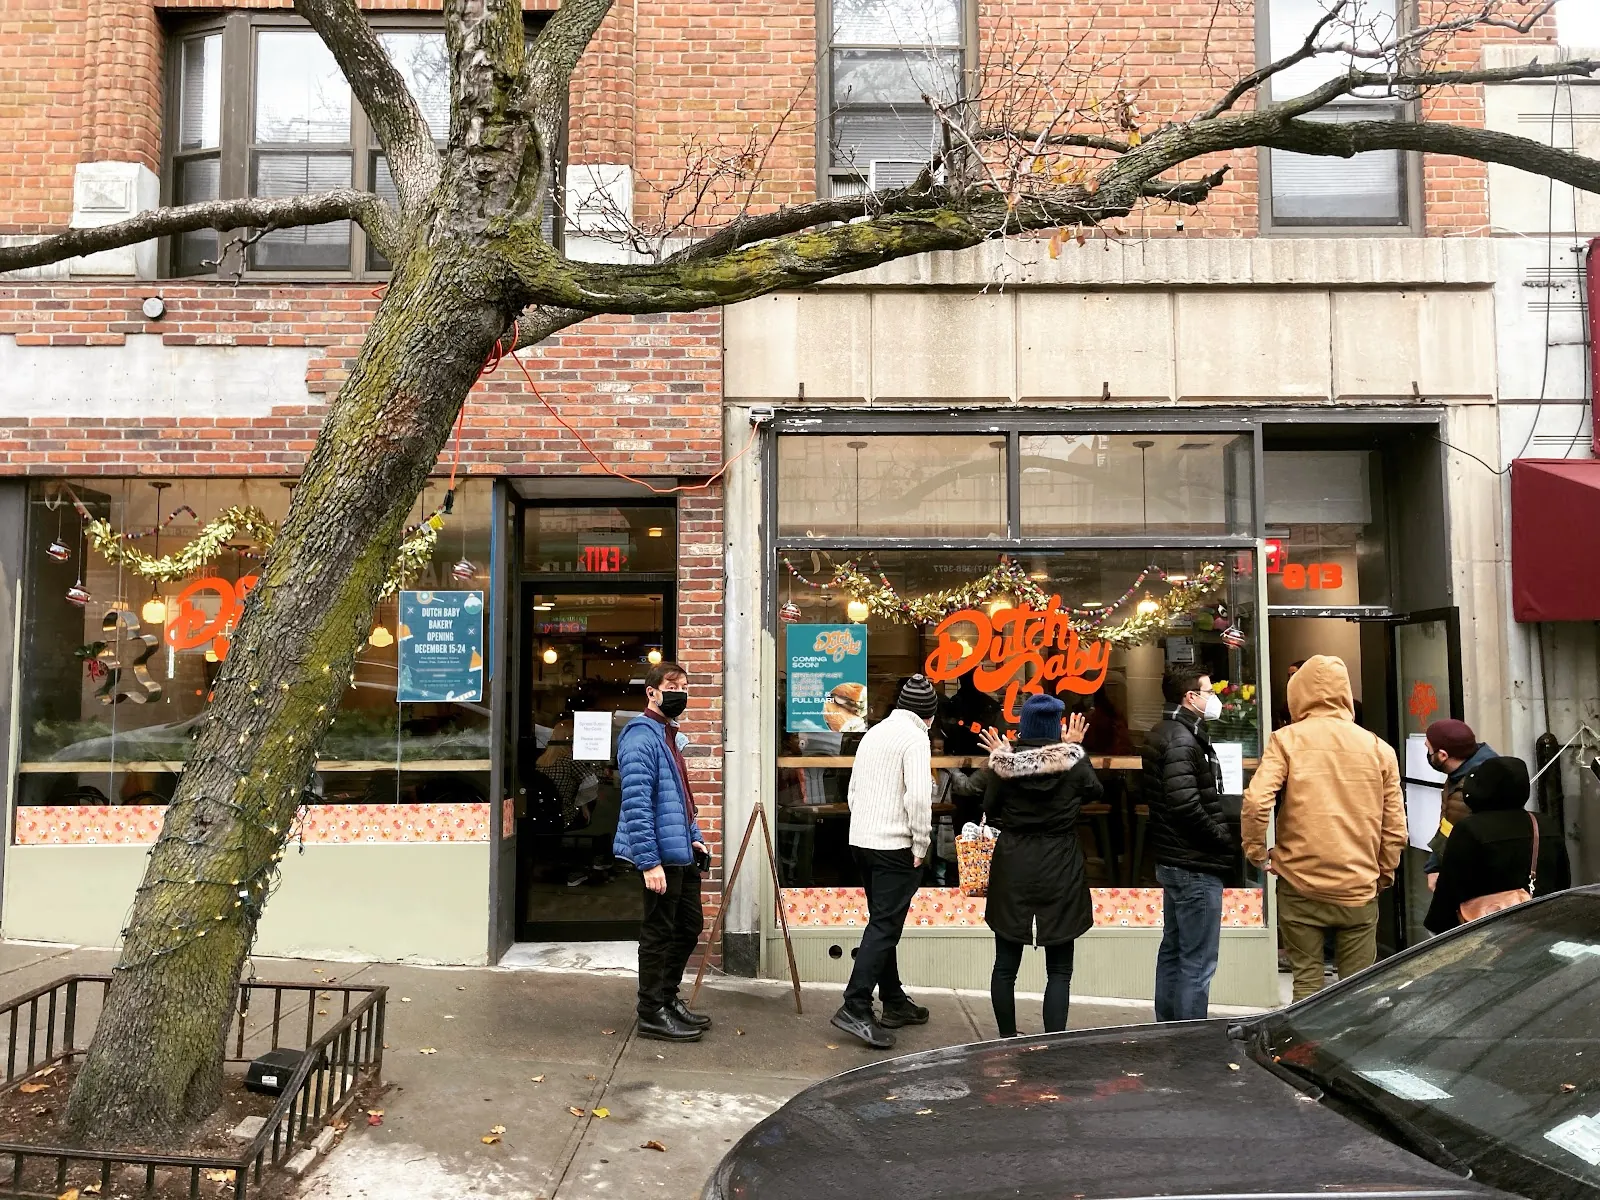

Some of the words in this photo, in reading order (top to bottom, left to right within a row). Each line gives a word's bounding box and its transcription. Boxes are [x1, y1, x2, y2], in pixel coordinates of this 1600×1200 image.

[1283, 563, 1343, 590] 813
[421, 607, 443, 617] DUTCH
[443, 607, 460, 617] BABY
[428, 619, 453, 630] BAKERY
[426, 632, 454, 642] OPENING
[813, 628, 854, 653] Dutch
[925, 594, 1069, 684] Dutch
[414, 644, 447, 654] DECEMBER
[449, 644, 466, 654] 15-24
[973, 632, 1111, 723] Baby
